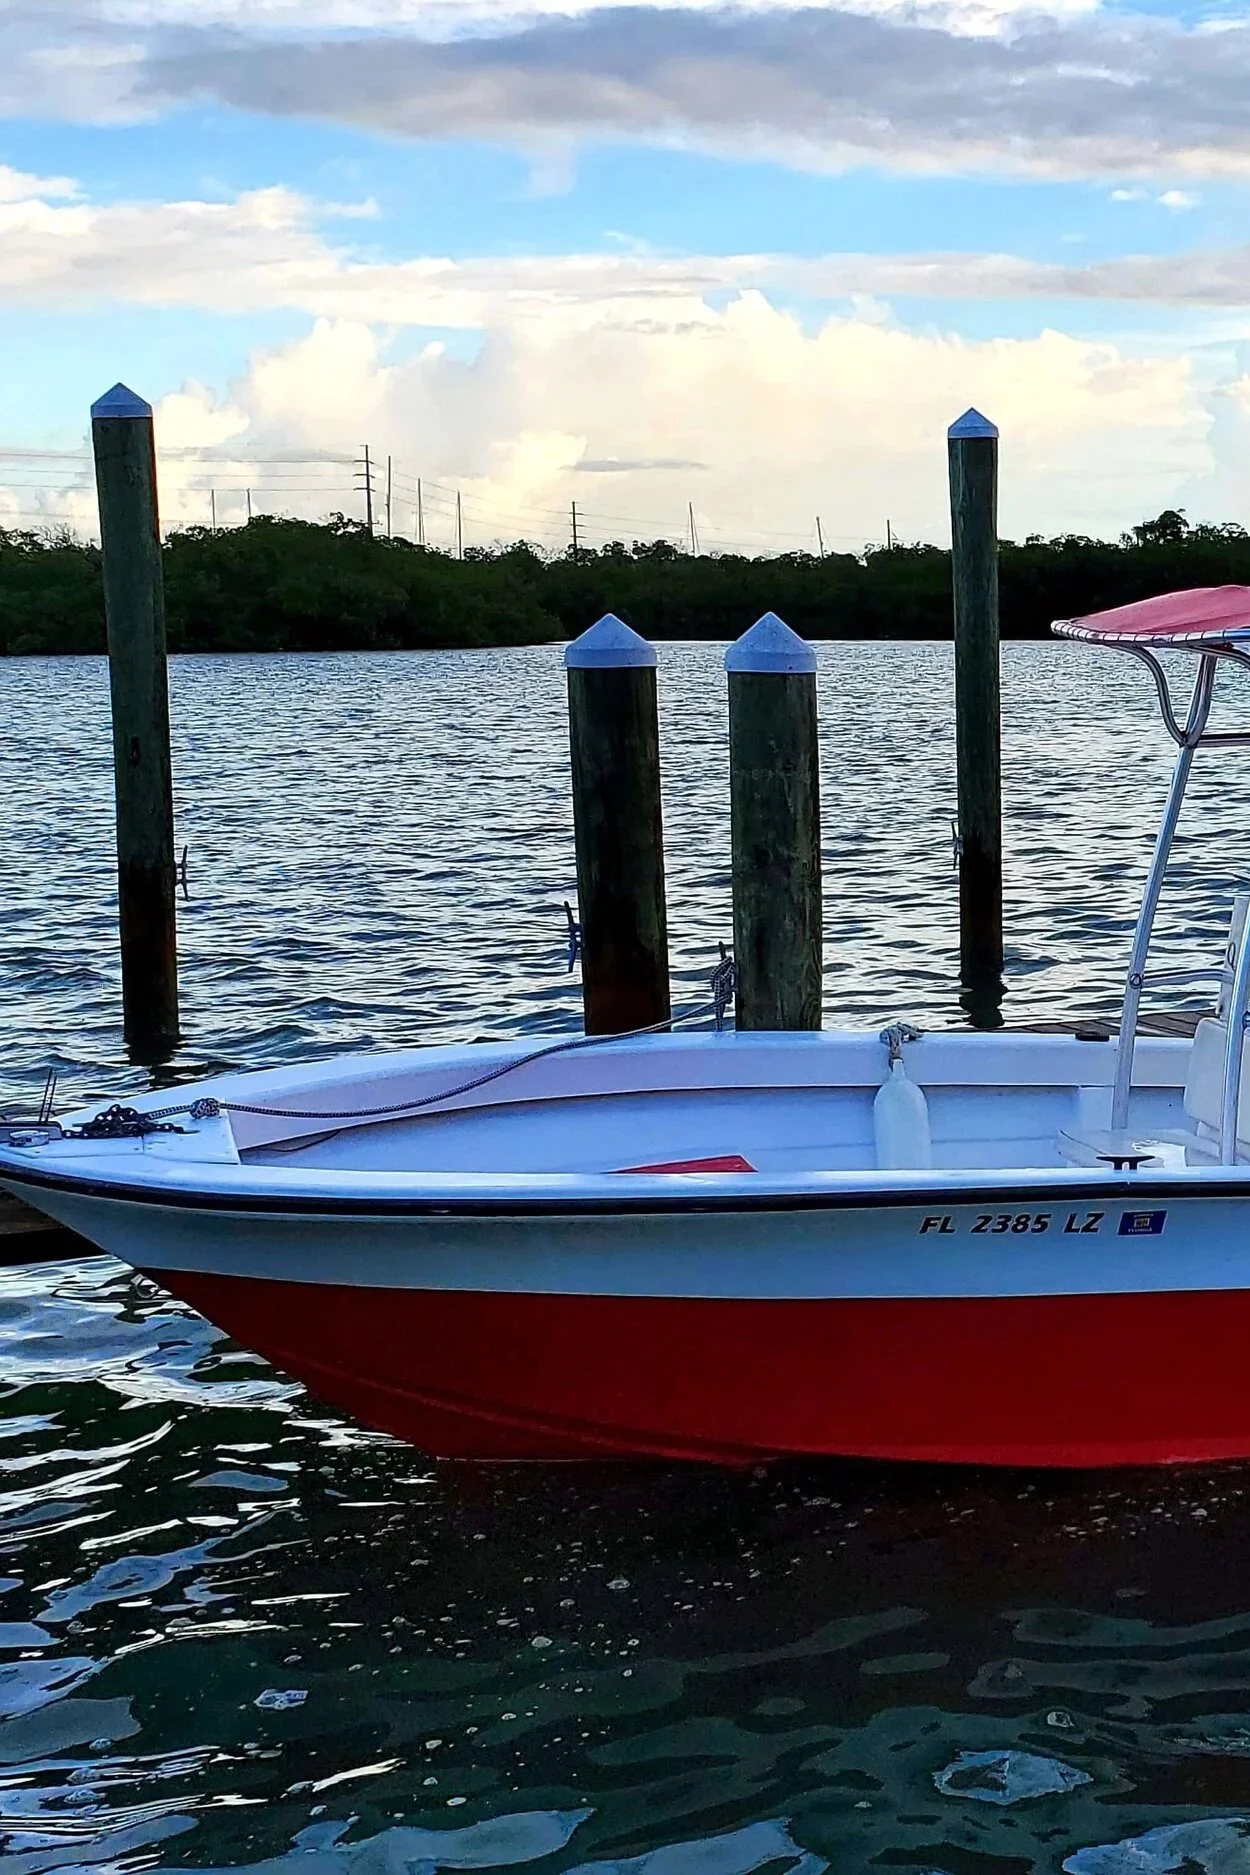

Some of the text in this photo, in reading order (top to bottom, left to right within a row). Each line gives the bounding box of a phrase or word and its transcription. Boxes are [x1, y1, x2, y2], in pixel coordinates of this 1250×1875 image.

[919, 1212, 1105, 1234] FL 2385 LZ
